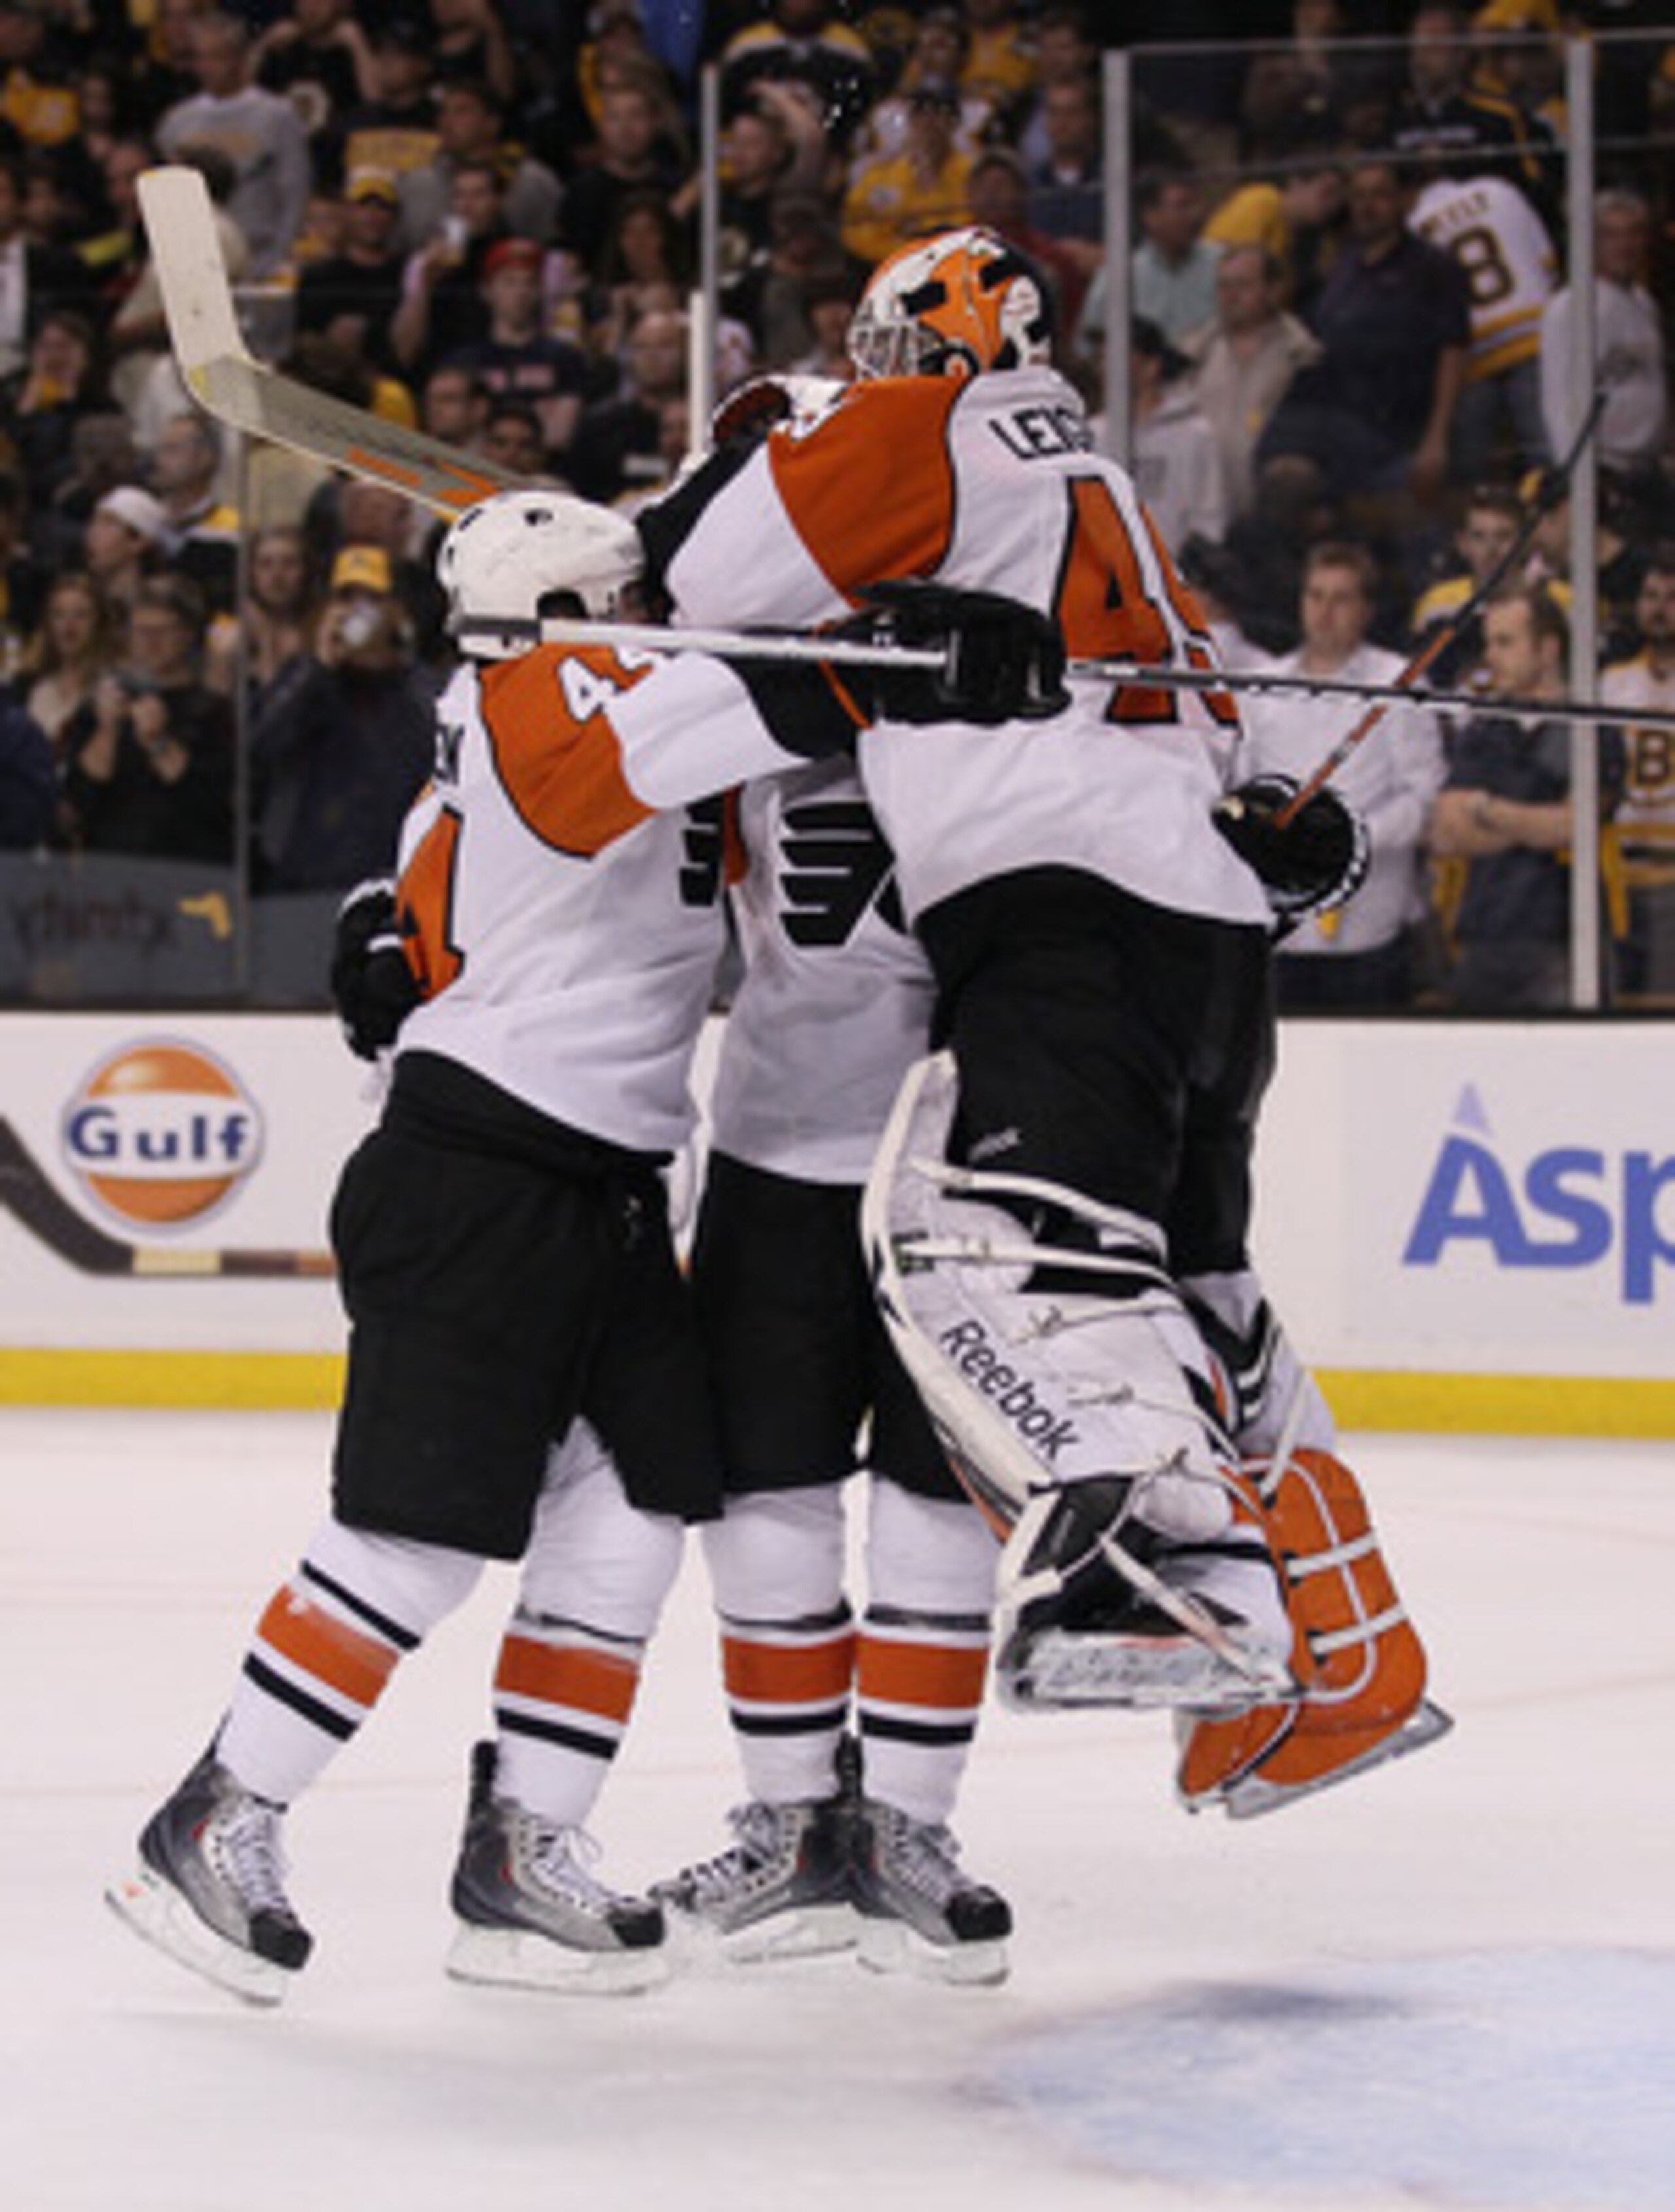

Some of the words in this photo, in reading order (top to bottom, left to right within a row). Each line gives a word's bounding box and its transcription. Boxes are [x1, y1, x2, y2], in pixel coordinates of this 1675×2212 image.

[69, 1106, 248, 1160] Gulf
[1402, 1081, 1675, 1304] Asp
[940, 1320, 1080, 1459] Reebok
